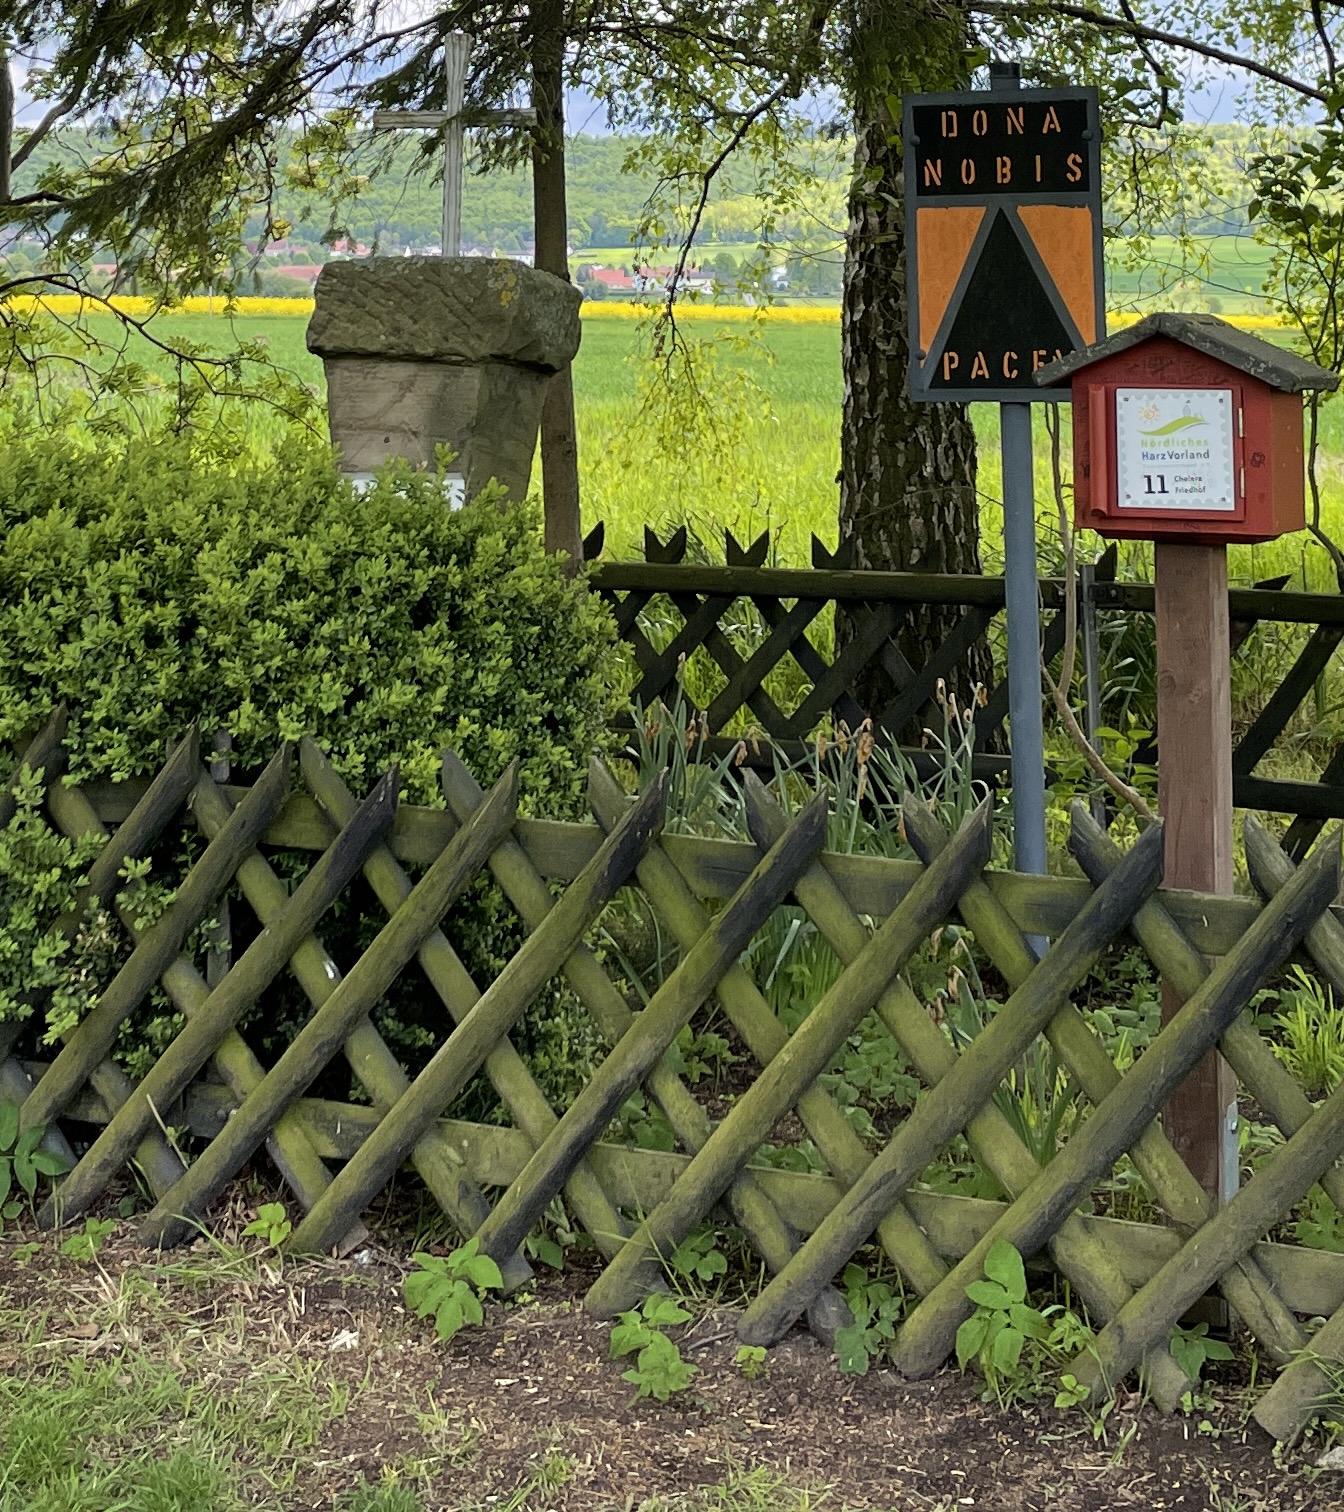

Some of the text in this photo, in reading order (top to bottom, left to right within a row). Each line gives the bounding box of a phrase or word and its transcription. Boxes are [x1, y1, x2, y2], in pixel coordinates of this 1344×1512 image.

[941, 106, 1061, 137] DONA
[924, 153, 1083, 186] NOBIS
[1140, 437, 1209, 448] Nördliches
[1143, 474, 1169, 494] 11
[1175, 486, 1206, 494] Friedhof
